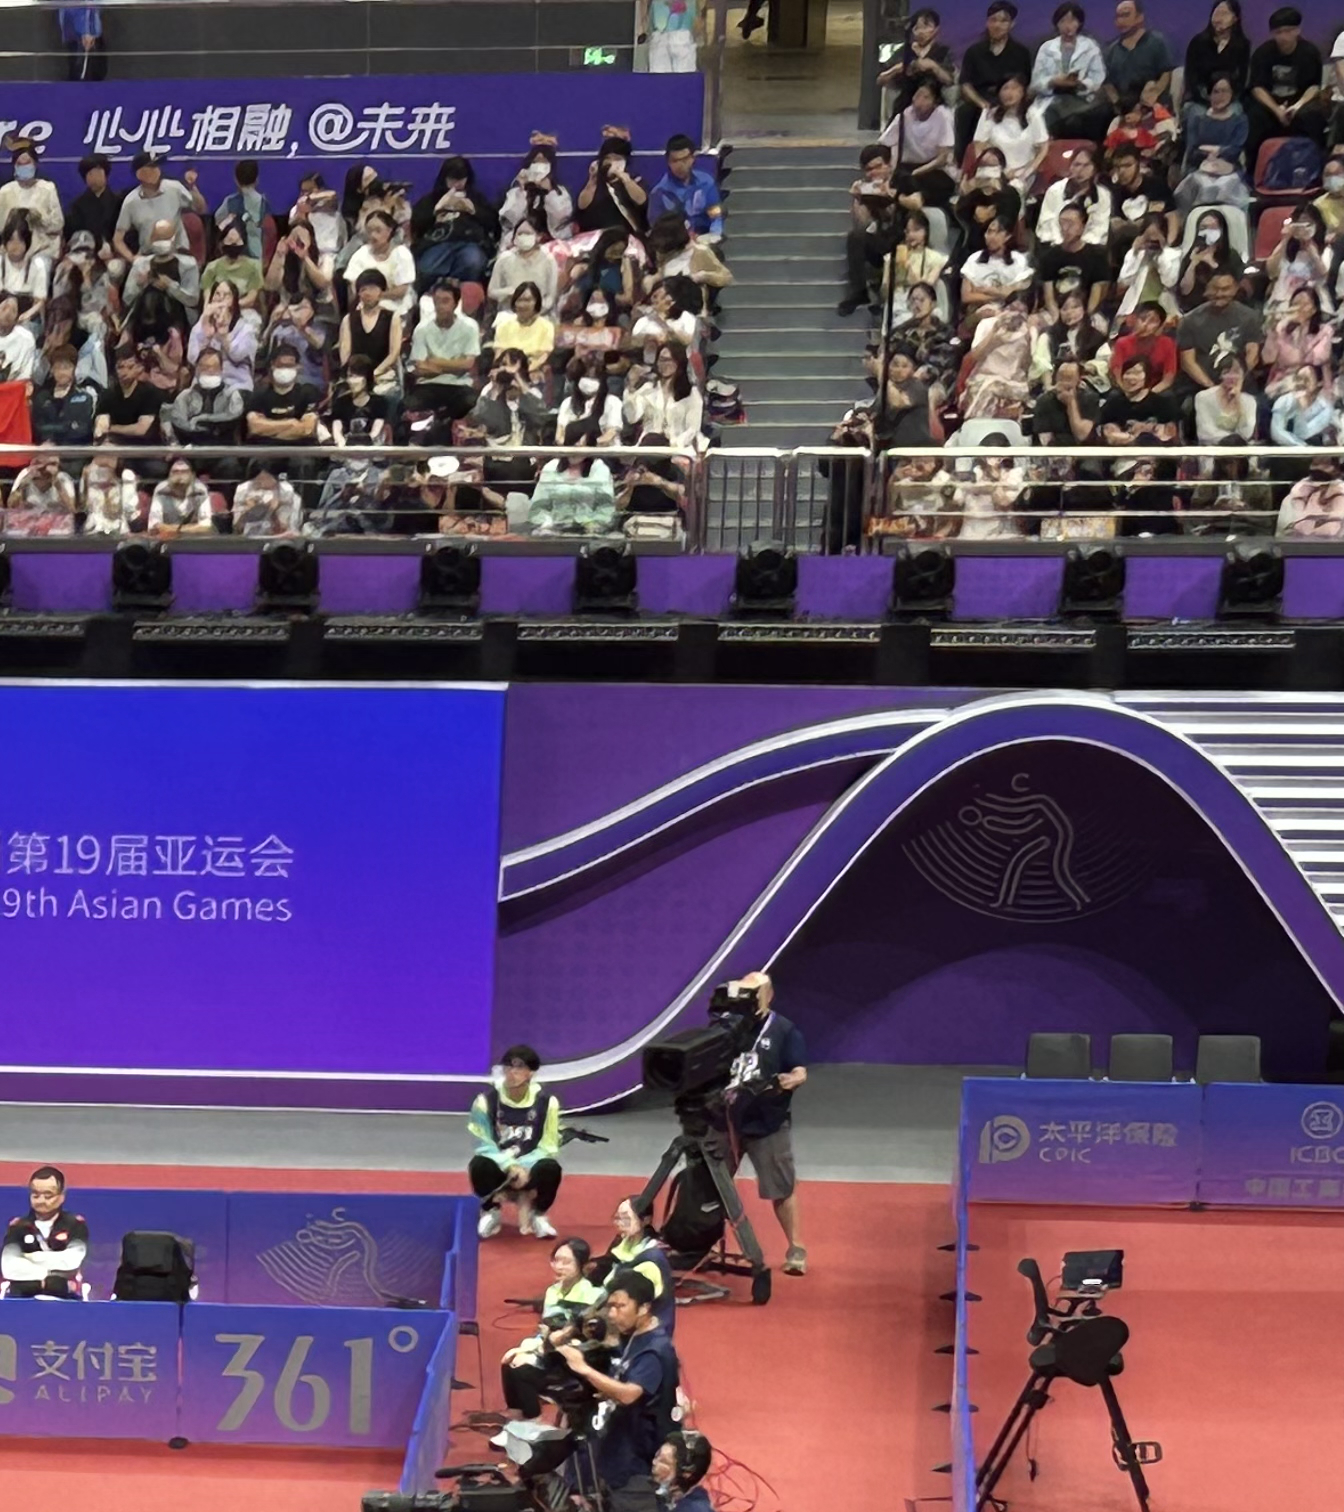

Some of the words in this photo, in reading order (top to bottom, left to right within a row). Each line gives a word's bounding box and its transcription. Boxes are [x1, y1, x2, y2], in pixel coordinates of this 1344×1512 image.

[68, 889, 162, 920] Asian
[173, 891, 293, 922] Games
[30, 1340, 157, 1383] 支付宝
[34, 1384, 152, 1404] ALIPAY
